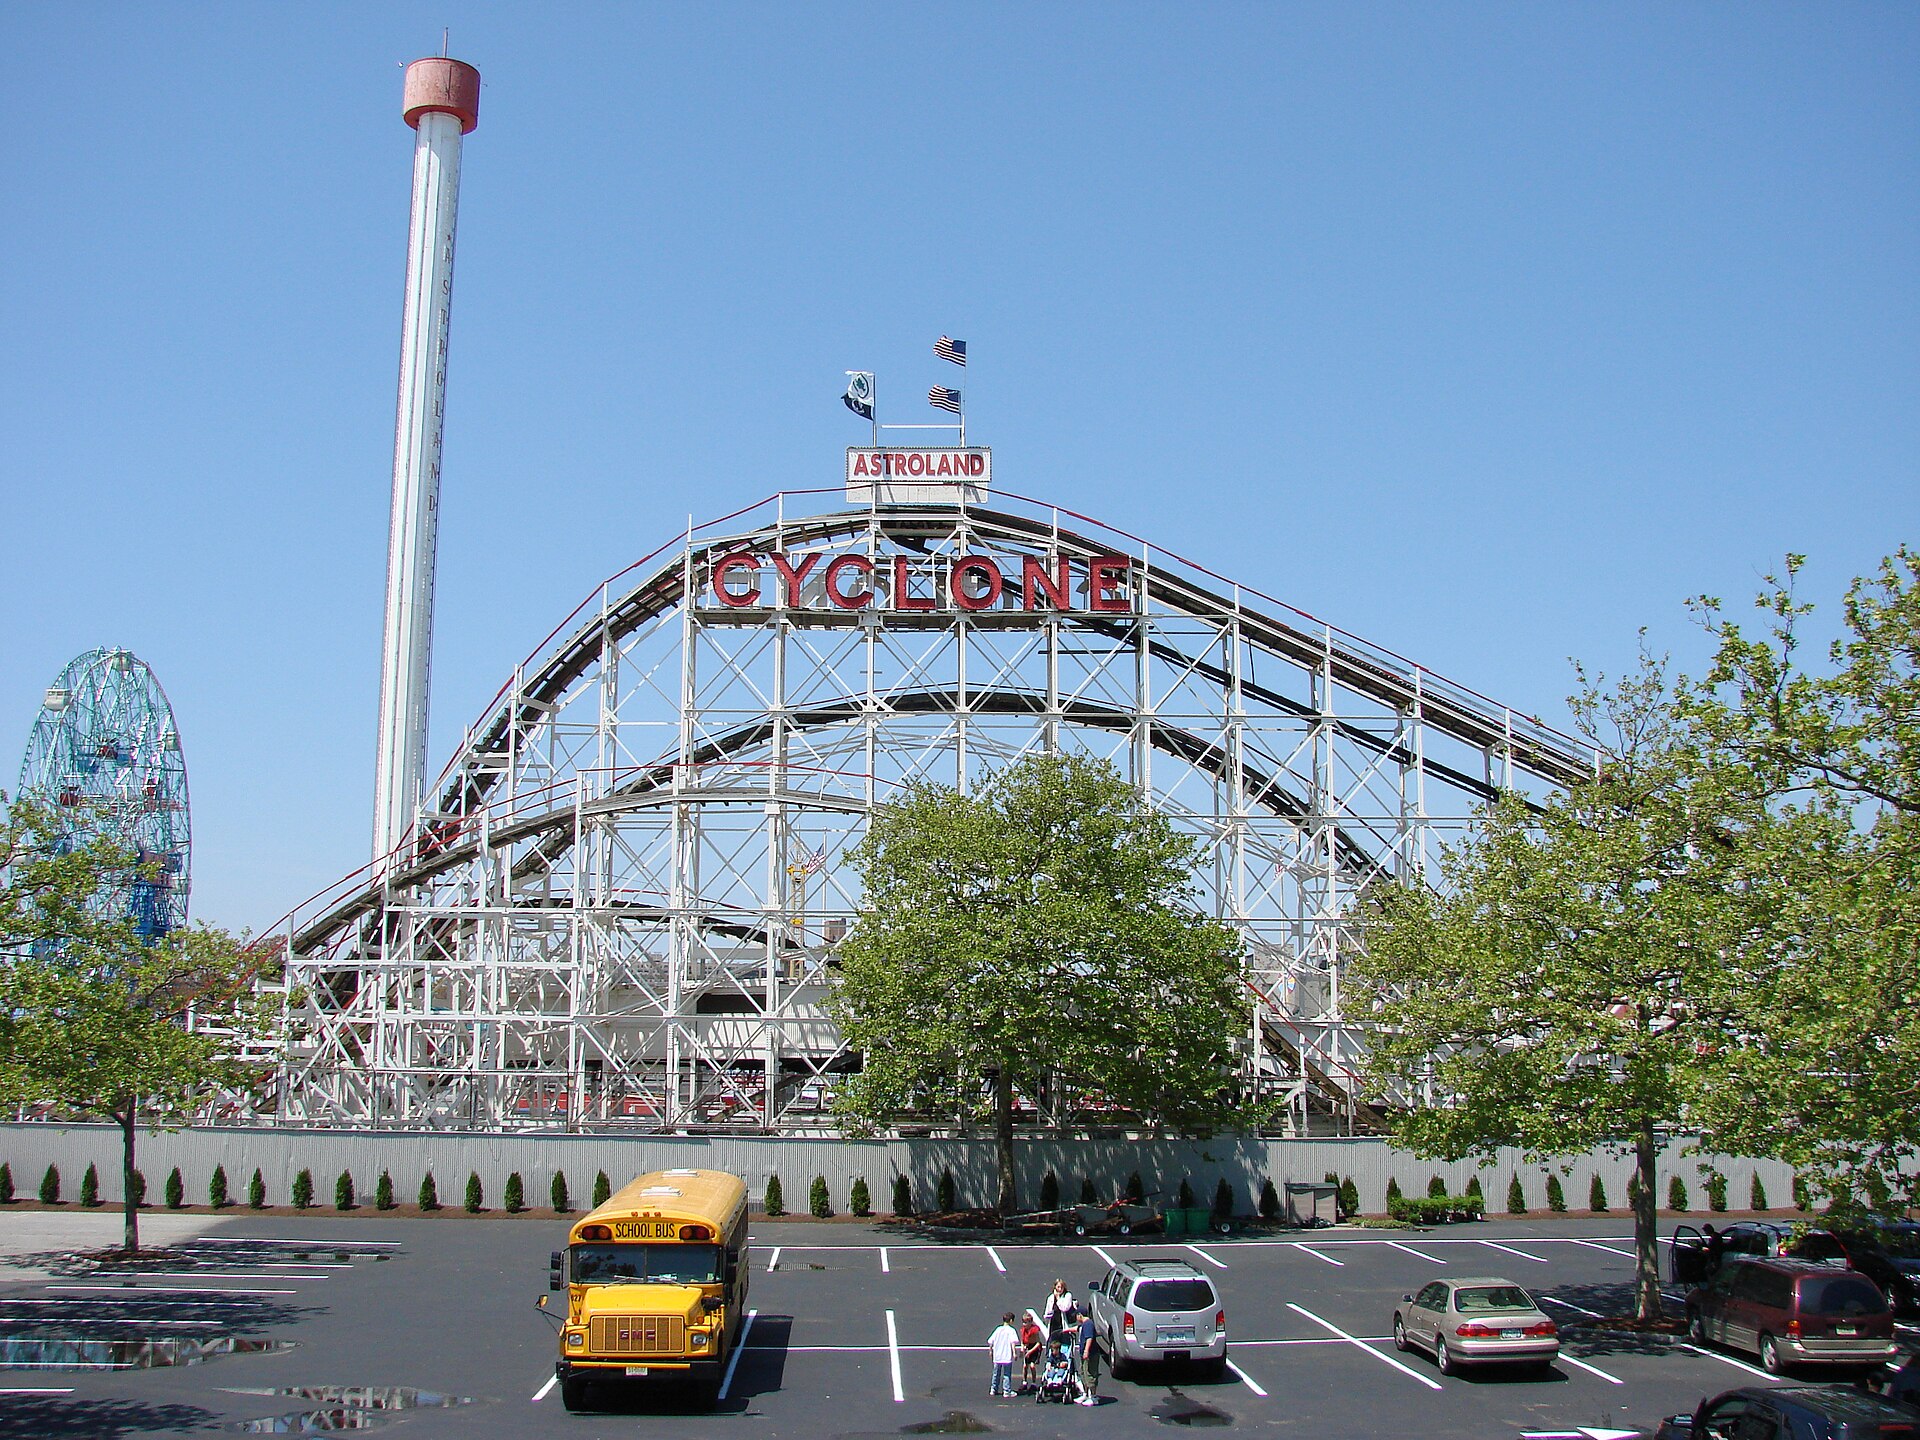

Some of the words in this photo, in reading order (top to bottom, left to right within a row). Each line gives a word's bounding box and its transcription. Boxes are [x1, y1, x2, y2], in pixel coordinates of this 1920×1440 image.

[428, 248, 452, 511] ASTROLAND
[854, 454, 985, 476] ASTROLAND
[713, 551, 1130, 611] CYCLONE
[615, 1223, 652, 1238] SCHOOL
[656, 1223, 675, 1237] BUS
